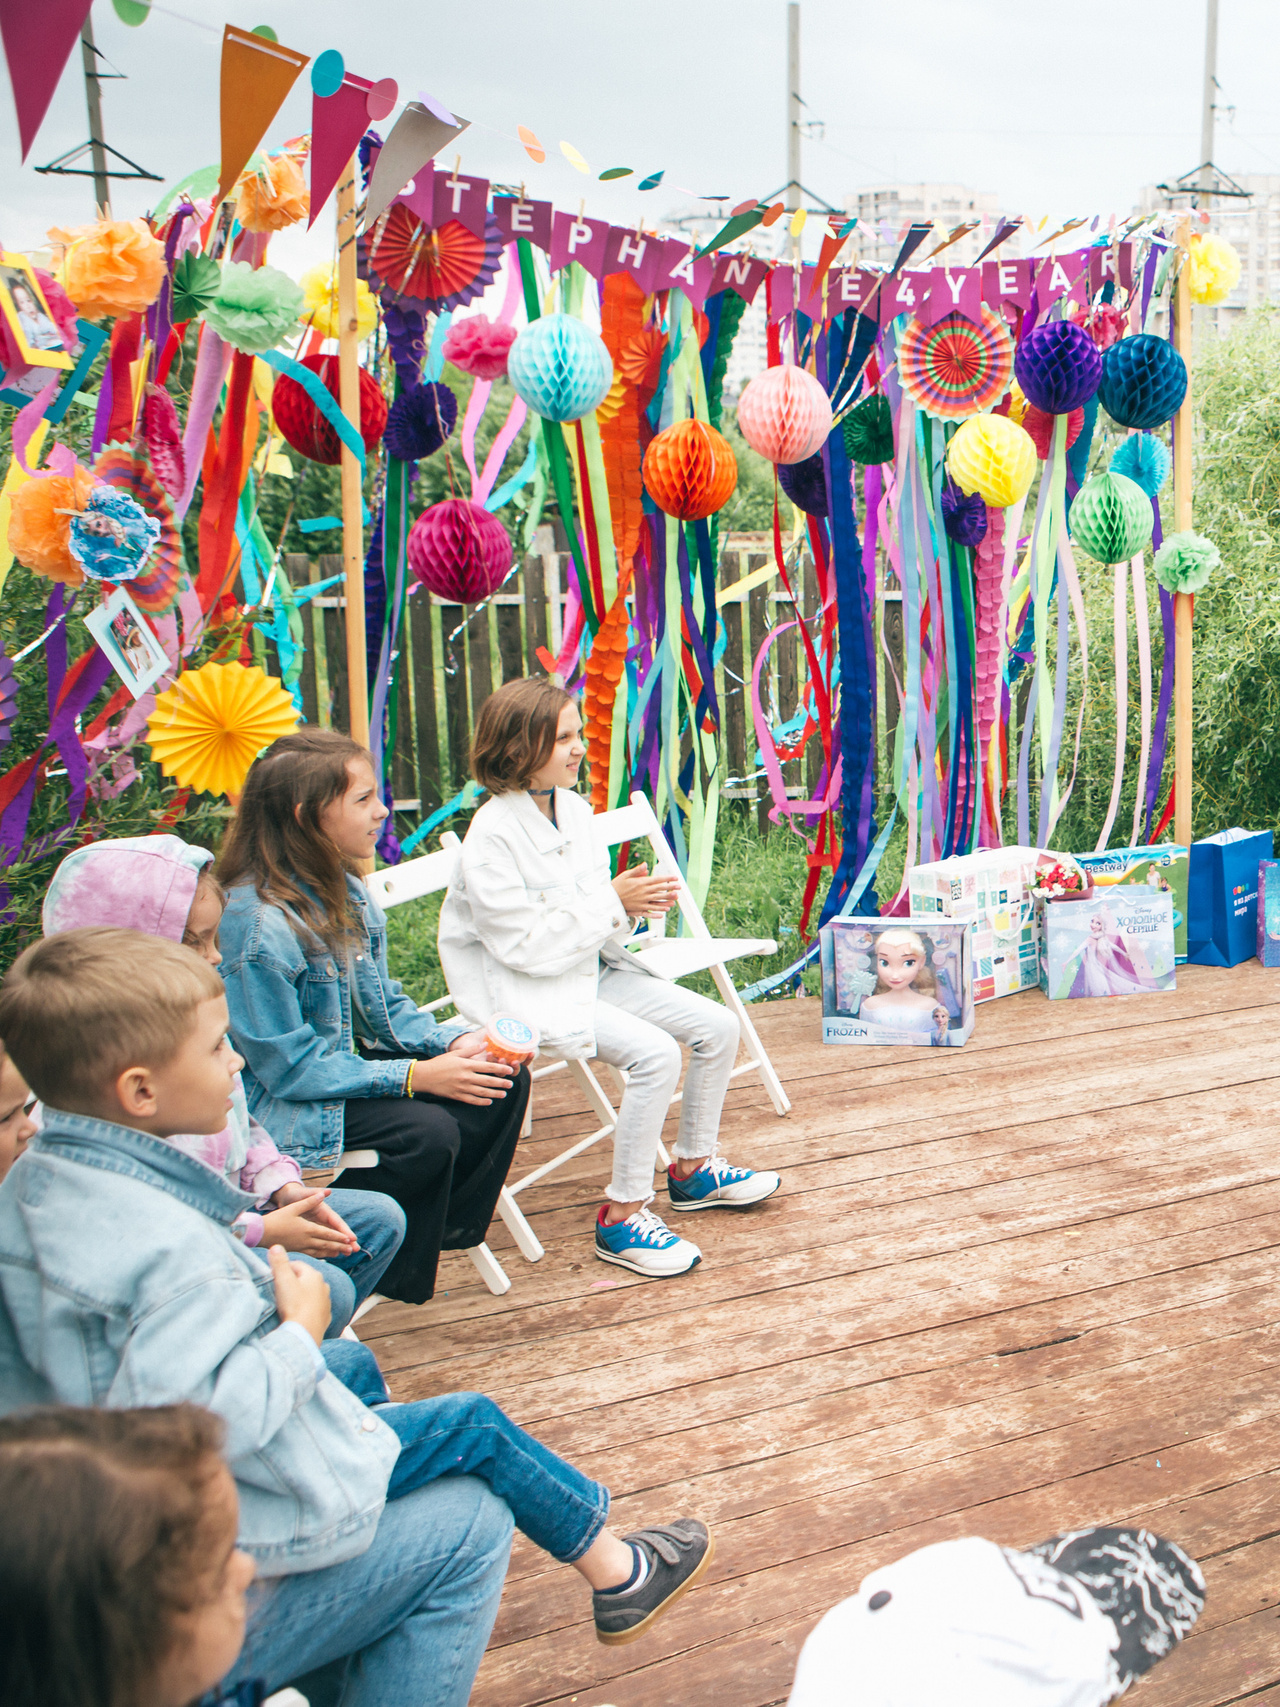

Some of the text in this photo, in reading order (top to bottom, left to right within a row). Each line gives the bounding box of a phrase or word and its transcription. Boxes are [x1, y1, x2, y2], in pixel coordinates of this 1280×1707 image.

[895, 276, 917, 307] 4
[1085, 862, 1128, 873] Bestway
[1116, 911, 1168, 928] ХОЛОДНОЕ
[1126, 922, 1159, 934] СЕРДЦЕ
[826, 1027, 868, 1037] FROZEN
